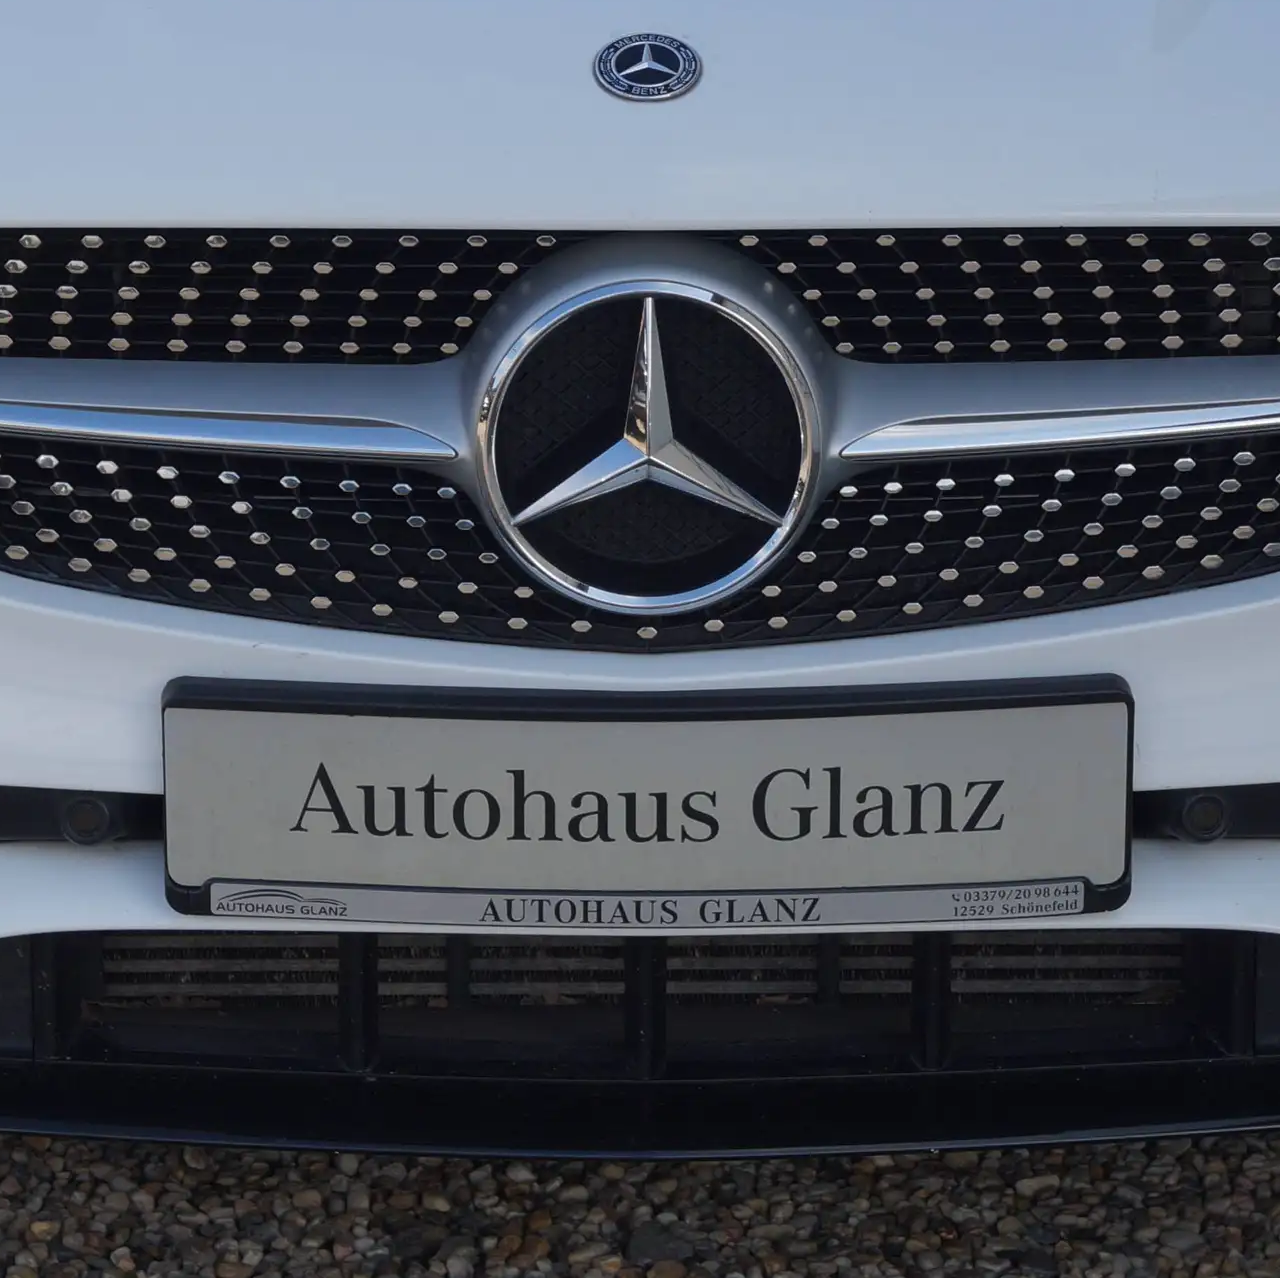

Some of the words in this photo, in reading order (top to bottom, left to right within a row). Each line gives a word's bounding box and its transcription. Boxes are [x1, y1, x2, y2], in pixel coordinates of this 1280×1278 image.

[614, 34, 681, 48] MERCEDES
[631, 86, 668, 95] BENZ
[290, 761, 719, 843] Autohaus
[751, 766, 1006, 841] Glanz
[216, 902, 295, 915] AUTOHAUS
[300, 905, 348, 917] GLANZ
[479, 898, 679, 925] AUTOHAUS
[699, 897, 821, 924] GLANZ
[953, 904, 995, 917] 12529
[1001, 899, 1079, 915] Schönefeld
